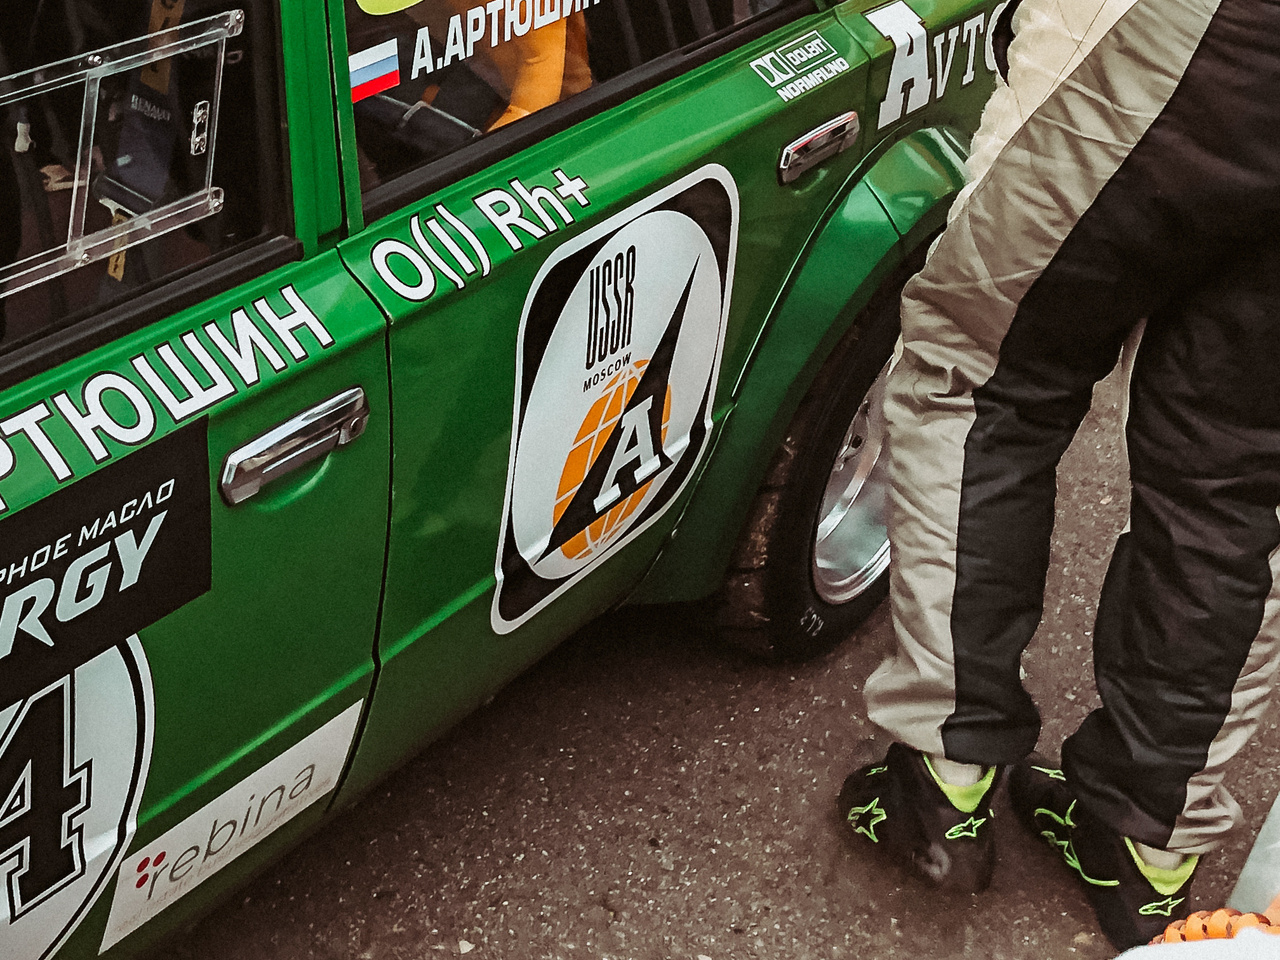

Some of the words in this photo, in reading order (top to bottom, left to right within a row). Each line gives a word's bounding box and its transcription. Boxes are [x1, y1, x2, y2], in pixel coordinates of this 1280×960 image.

[786, 38, 827, 66] DOLBIT
[472, 168, 590, 252] Rh+
[584, 243, 637, 371] USSR
[582, 351, 632, 393] MOSCOW
[78, 478, 175, 547] МАСЛО
[147, 763, 317, 901] rebina
